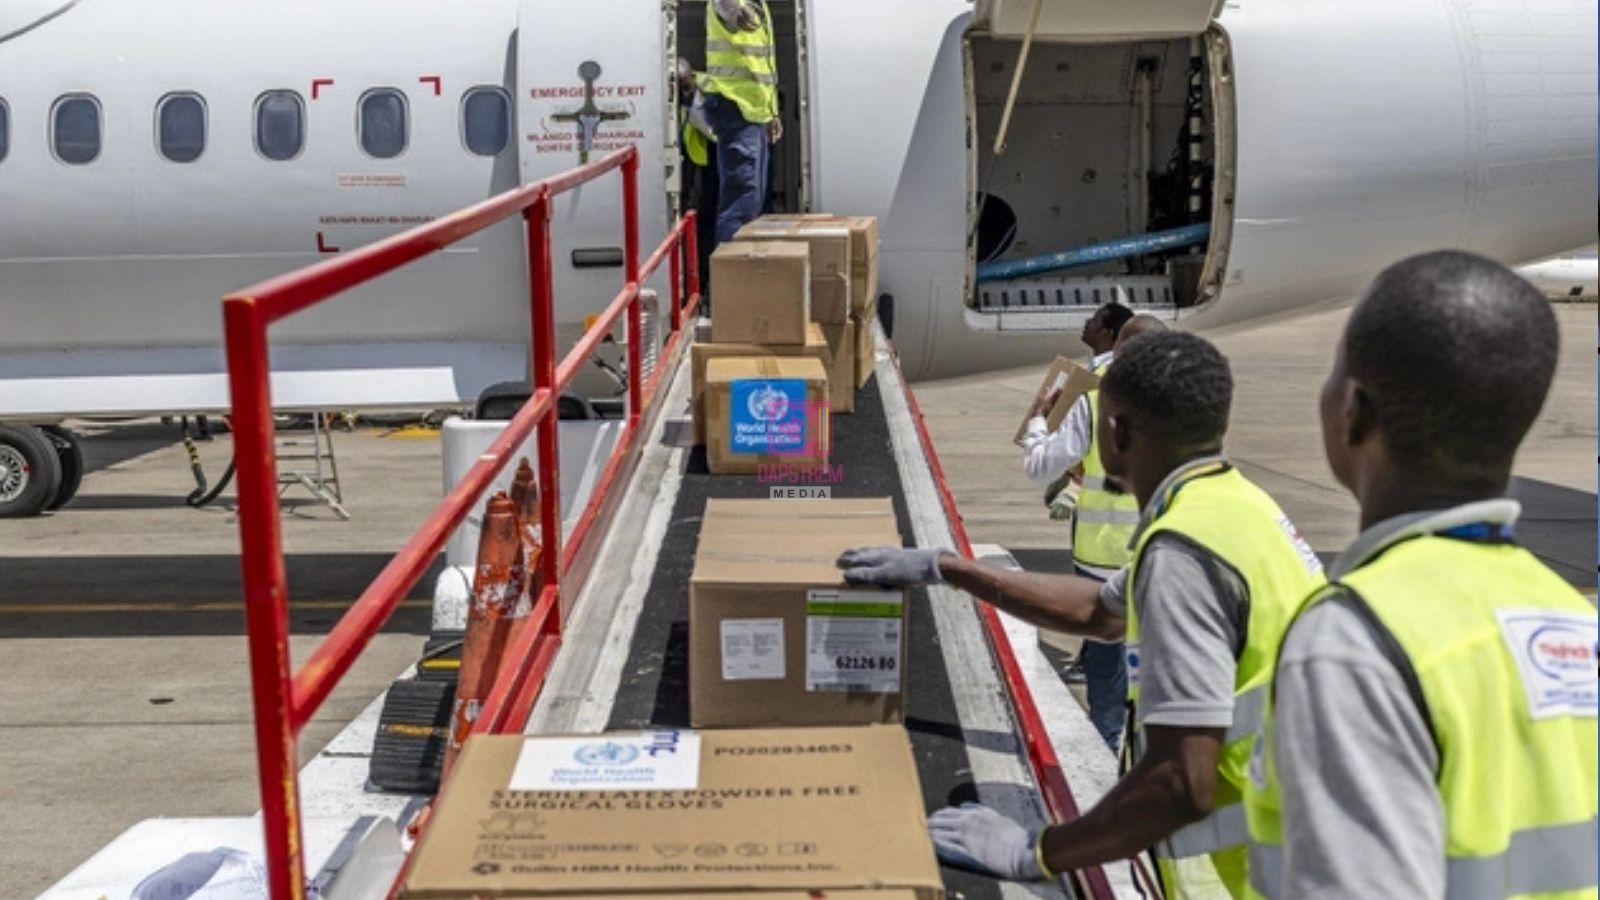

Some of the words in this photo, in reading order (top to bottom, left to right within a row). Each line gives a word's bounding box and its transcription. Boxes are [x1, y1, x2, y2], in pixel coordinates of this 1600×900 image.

[617, 85, 646, 96] EXIT
[536, 144, 573, 153] SORTIE
[735, 422, 766, 434] World
[767, 422, 802, 434] Health
[552, 766, 600, 776] World
[603, 766, 656, 776] Health
[550, 775, 655, 785] Organization
[491, 789, 586, 799] STERILE
[599, 788, 675, 799] LATEX
[683, 786, 794, 799] POWDER
[802, 784, 862, 796] FREE
[489, 799, 617, 810] SURGICAL
[625, 799, 725, 810] GLOVES
[625, 861, 690, 873] Health
